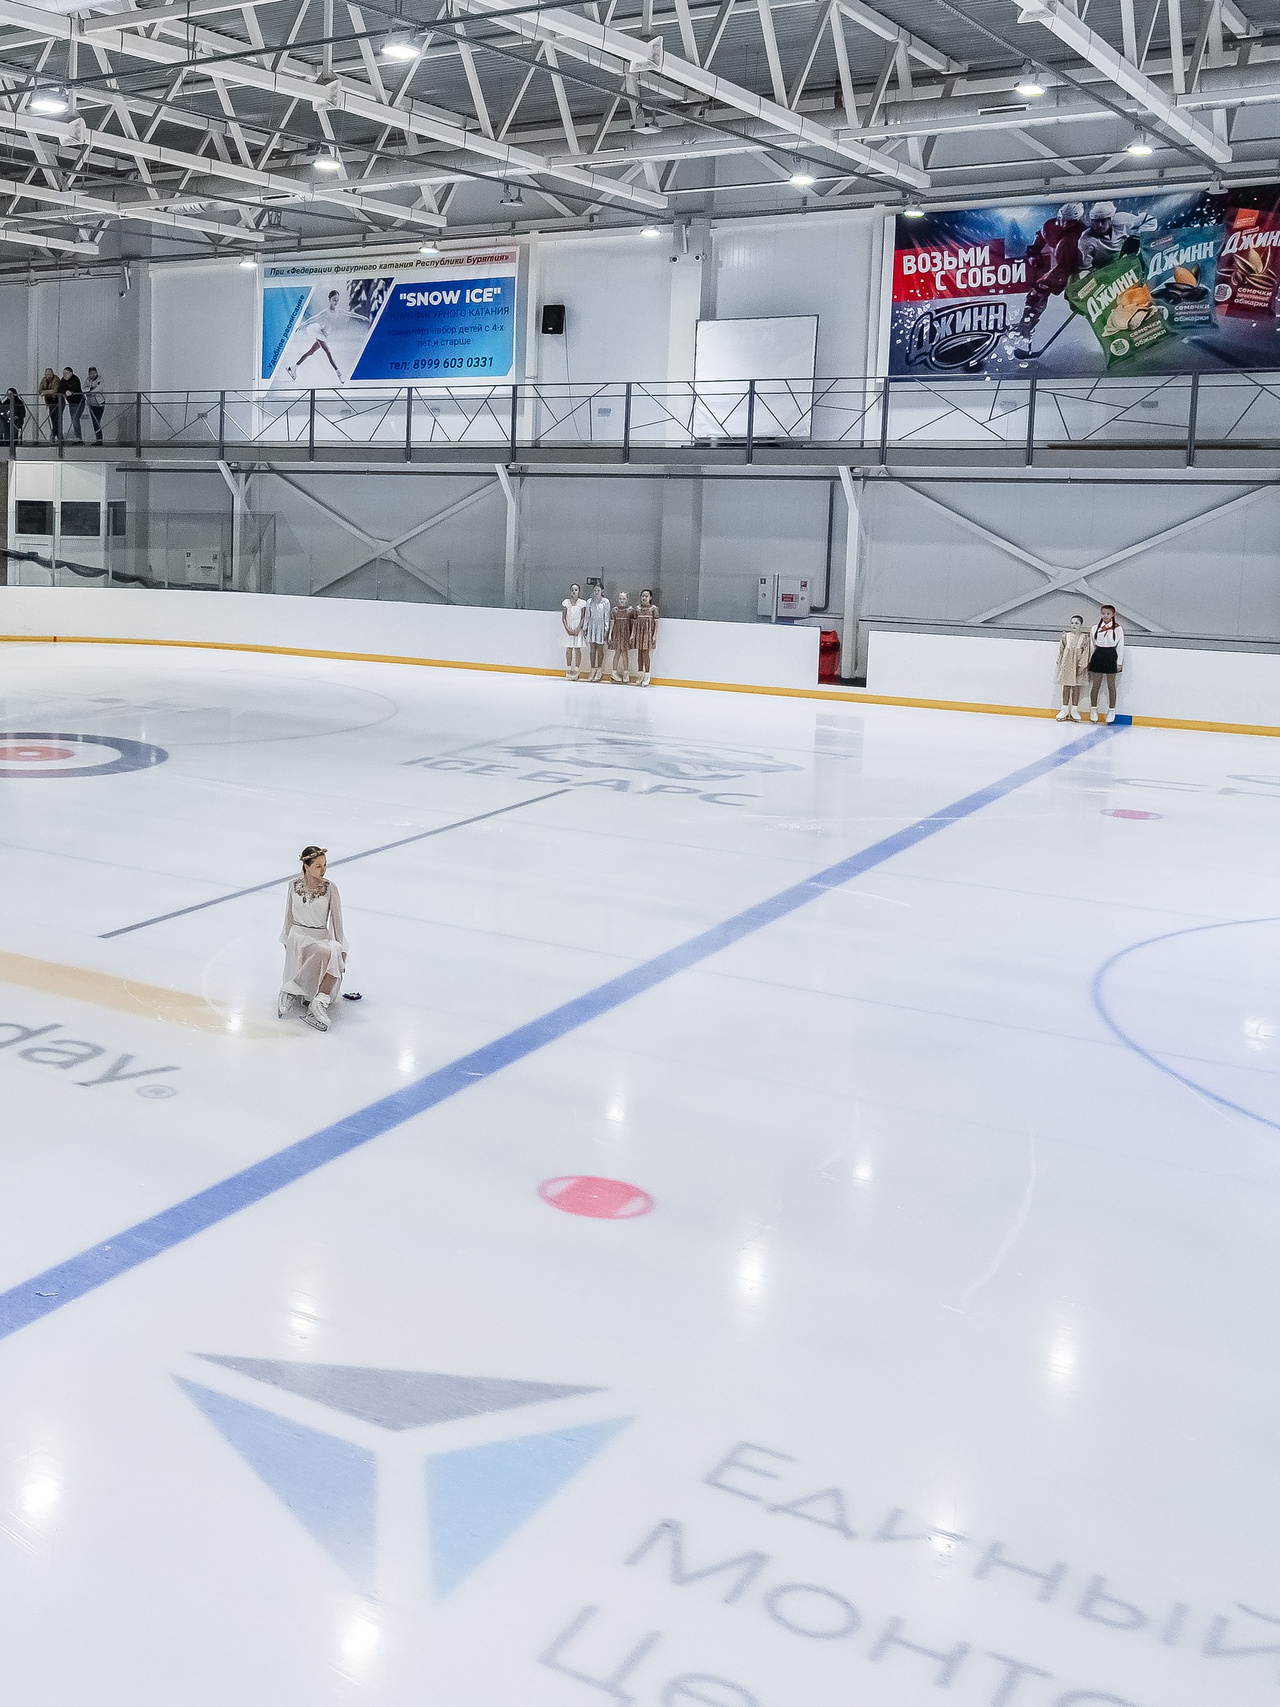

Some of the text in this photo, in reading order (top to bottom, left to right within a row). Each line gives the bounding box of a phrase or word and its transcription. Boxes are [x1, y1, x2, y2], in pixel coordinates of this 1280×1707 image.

[269, 267, 284, 276] При
[333, 264, 378, 275] фигурного
[379, 260, 413, 270] катания
[415, 256, 464, 268] Республики
[466, 254, 510, 264] Бурятия»
[902, 245, 990, 275] ВОЗЬМИ
[935, 259, 1027, 291] С СОБОЙ
[399, 287, 502, 307] "SNOW ICE"
[468, 306, 510, 317] КАТАНИЯ
[431, 325, 457, 335] набор
[458, 323, 483, 334] детей
[492, 323, 504, 332] 4-х
[440, 337, 472, 348] старше
[389, 356, 494, 370] тел: 8999 603 0331
